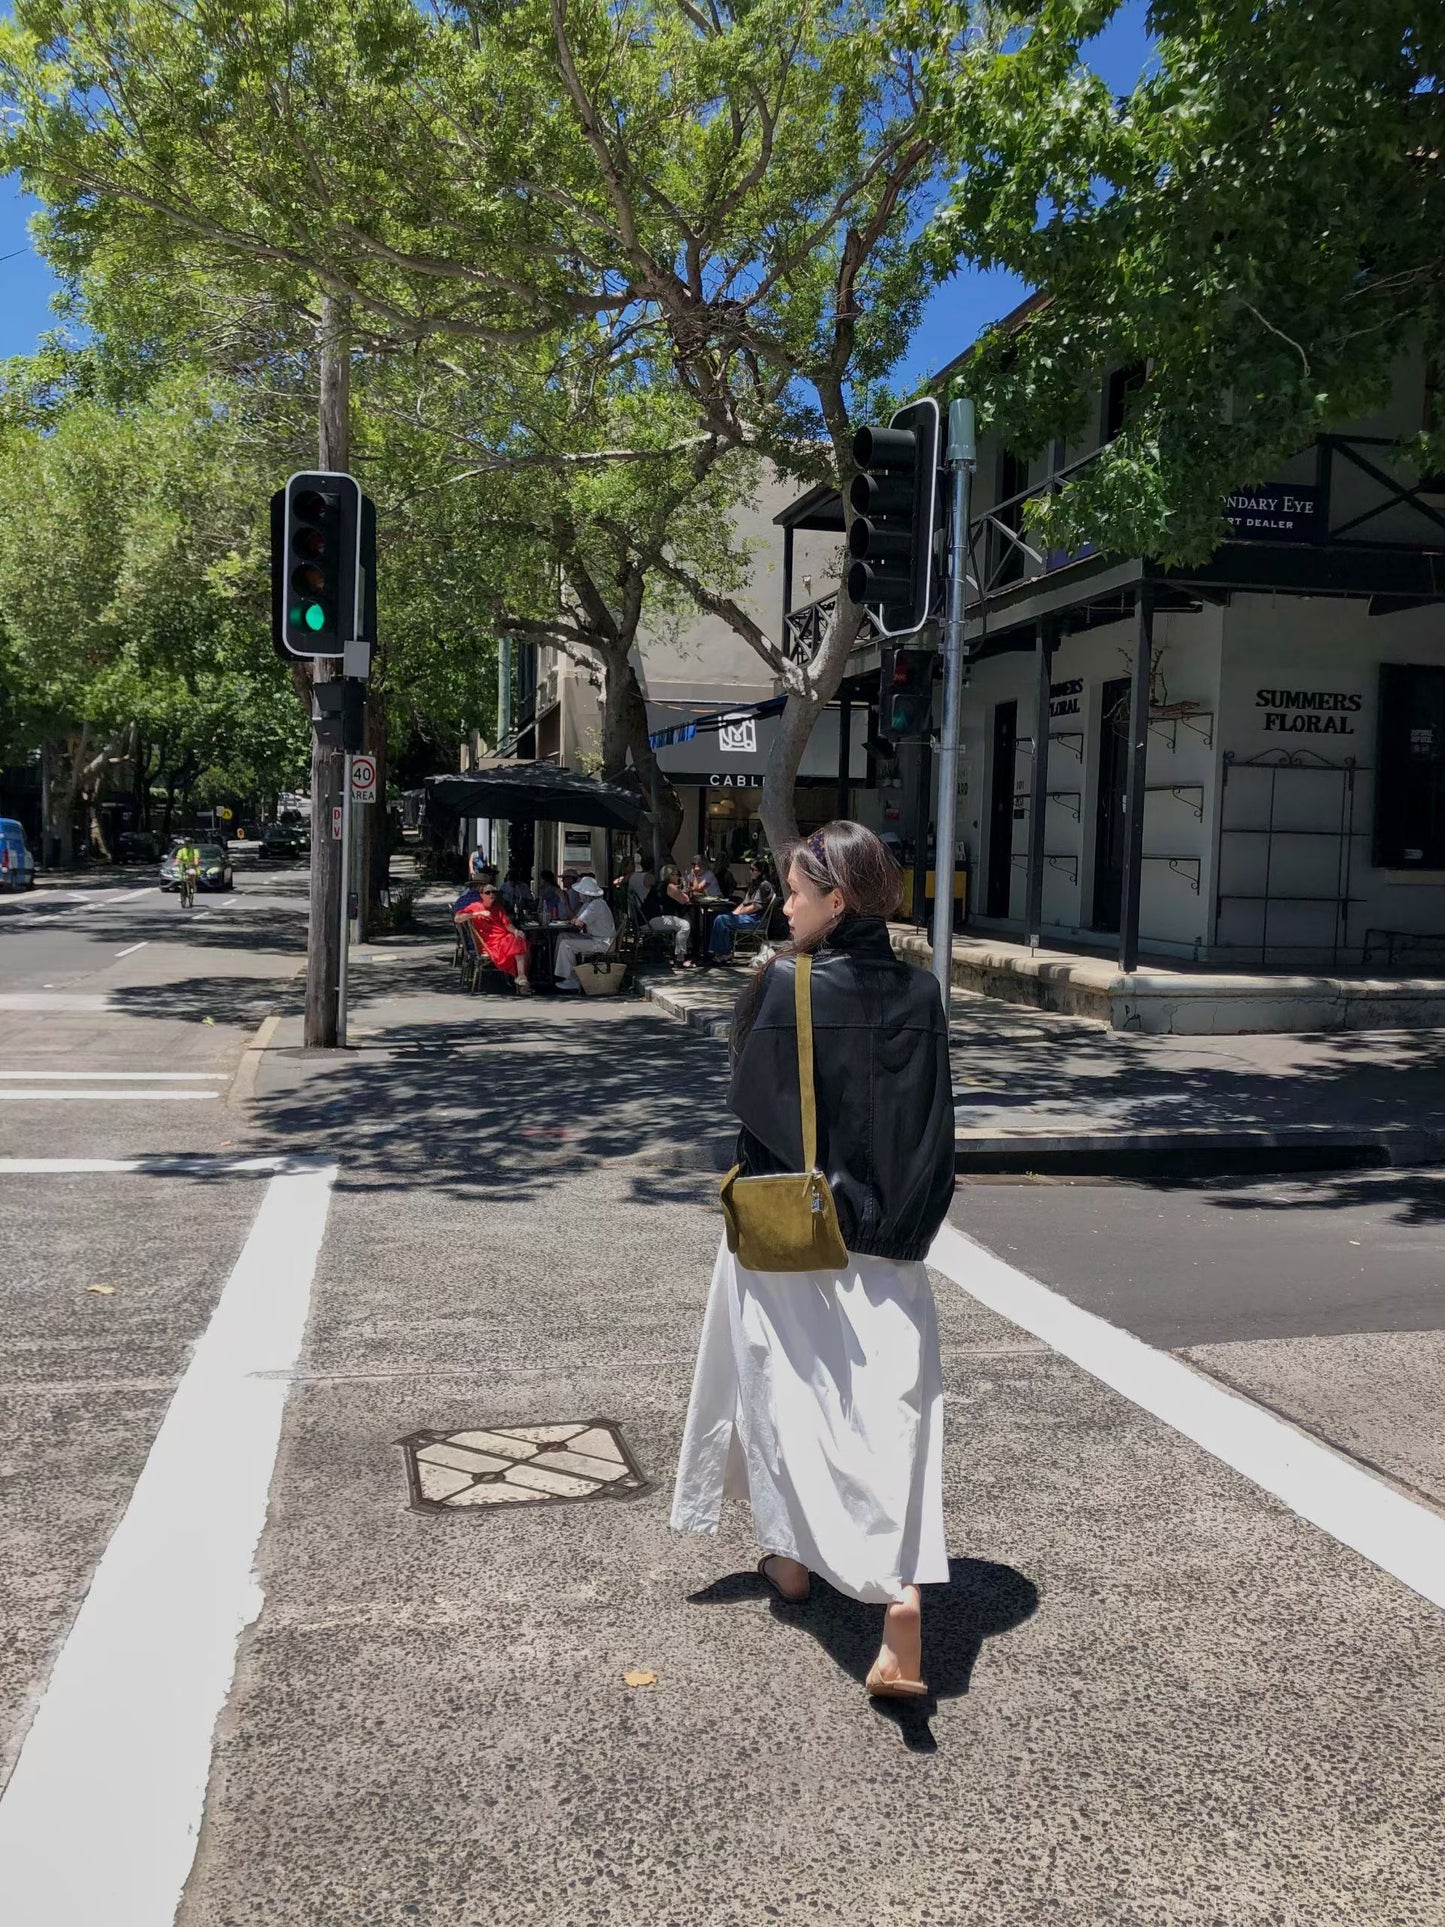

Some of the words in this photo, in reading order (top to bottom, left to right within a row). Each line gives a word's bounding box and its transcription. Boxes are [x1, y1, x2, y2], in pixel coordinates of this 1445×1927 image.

[1221, 517, 1242, 526] RT
[1246, 518, 1294, 529] DEALER
[1049, 698, 1081, 718] LORAL
[1256, 689, 1362, 712] SUMMERS
[1264, 712, 1354, 734] FLORAL
[353, 767, 371, 781] 40
